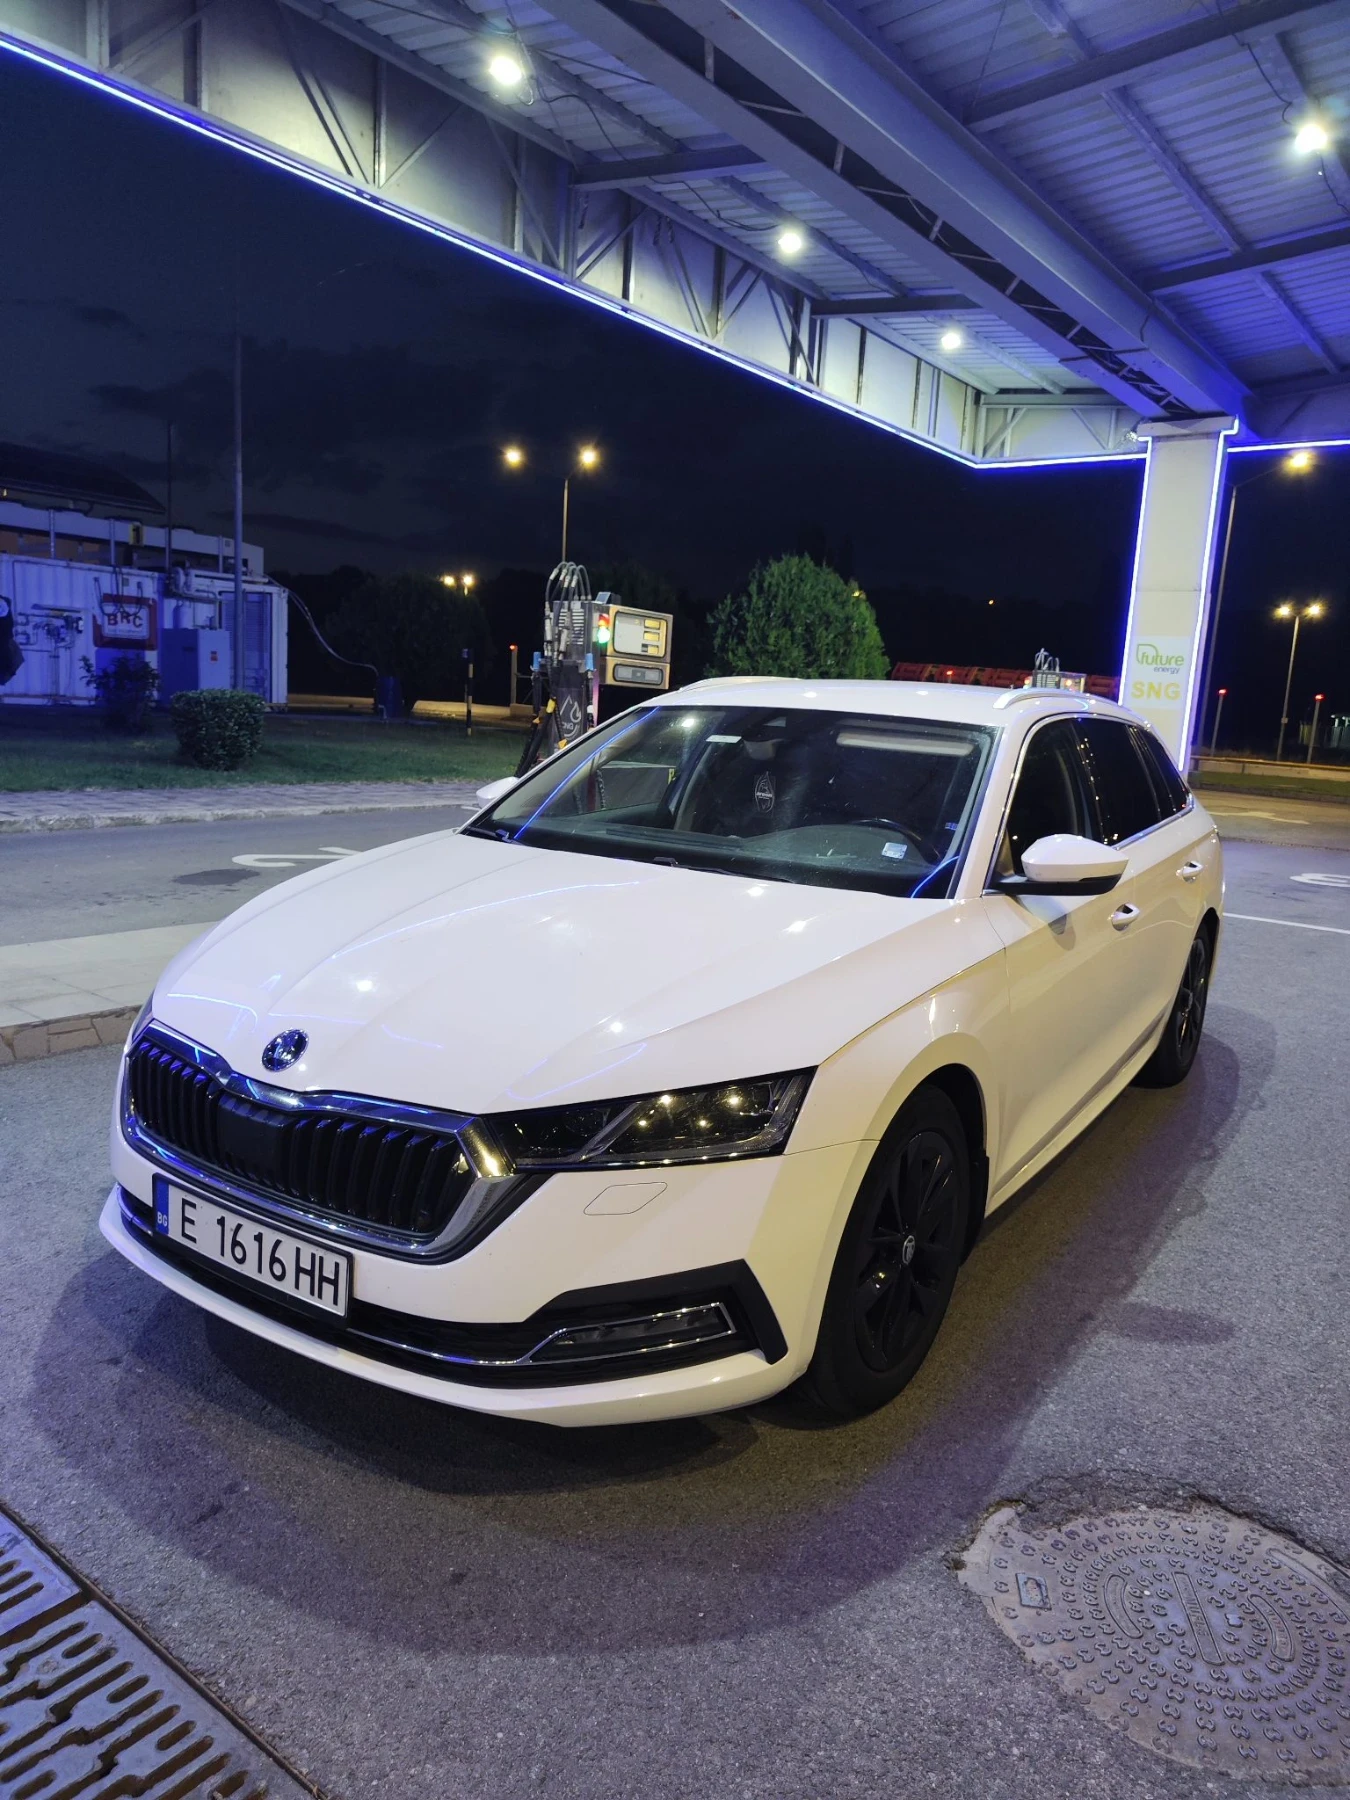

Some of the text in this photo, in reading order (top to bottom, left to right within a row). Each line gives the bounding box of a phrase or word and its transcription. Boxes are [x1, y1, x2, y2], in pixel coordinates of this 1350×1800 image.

[107, 611, 144, 628] BRC
[1138, 648, 1185, 666] future
[1153, 666, 1180, 675] energy
[1131, 680, 1181, 700] SNG
[156, 1213, 168, 1227] BG
[181, 1197, 197, 1244] E
